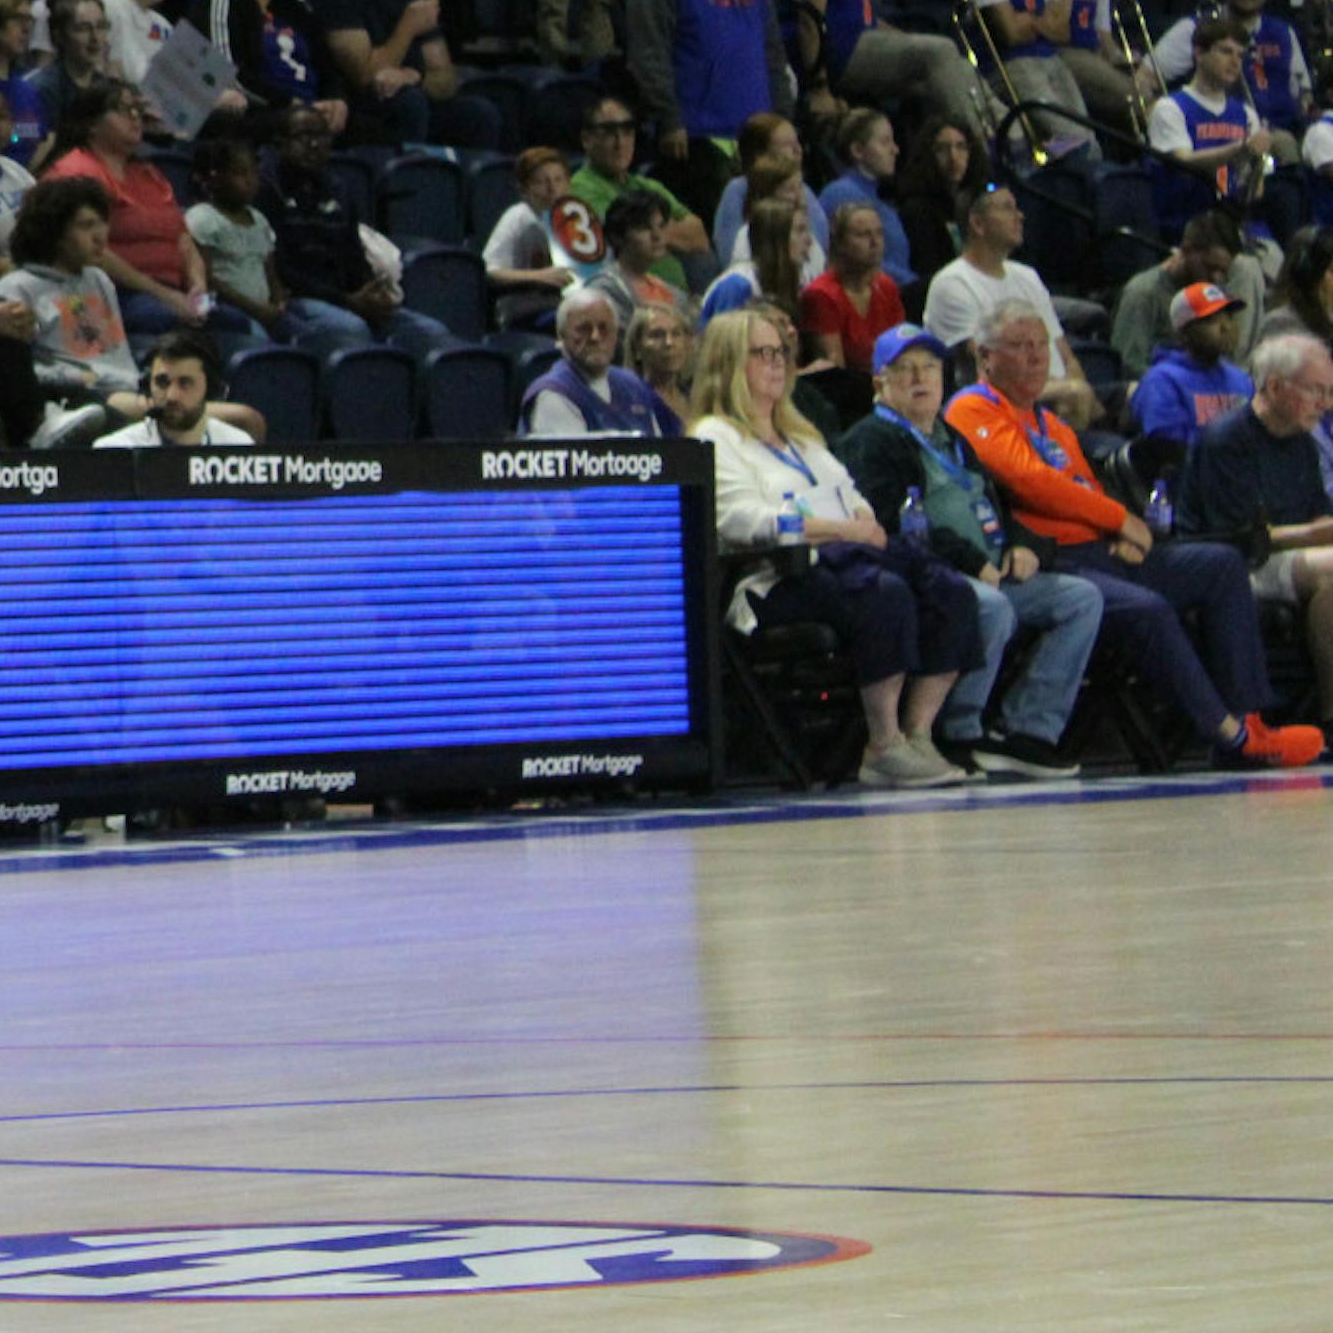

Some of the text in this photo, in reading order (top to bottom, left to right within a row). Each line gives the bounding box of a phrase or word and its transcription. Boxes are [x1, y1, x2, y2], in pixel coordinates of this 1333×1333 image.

[562, 199, 599, 256] 3
[189, 455, 282, 485] ROCKET
[482, 449, 569, 479] ROCKET
[226, 769, 289, 796] ROCKET
